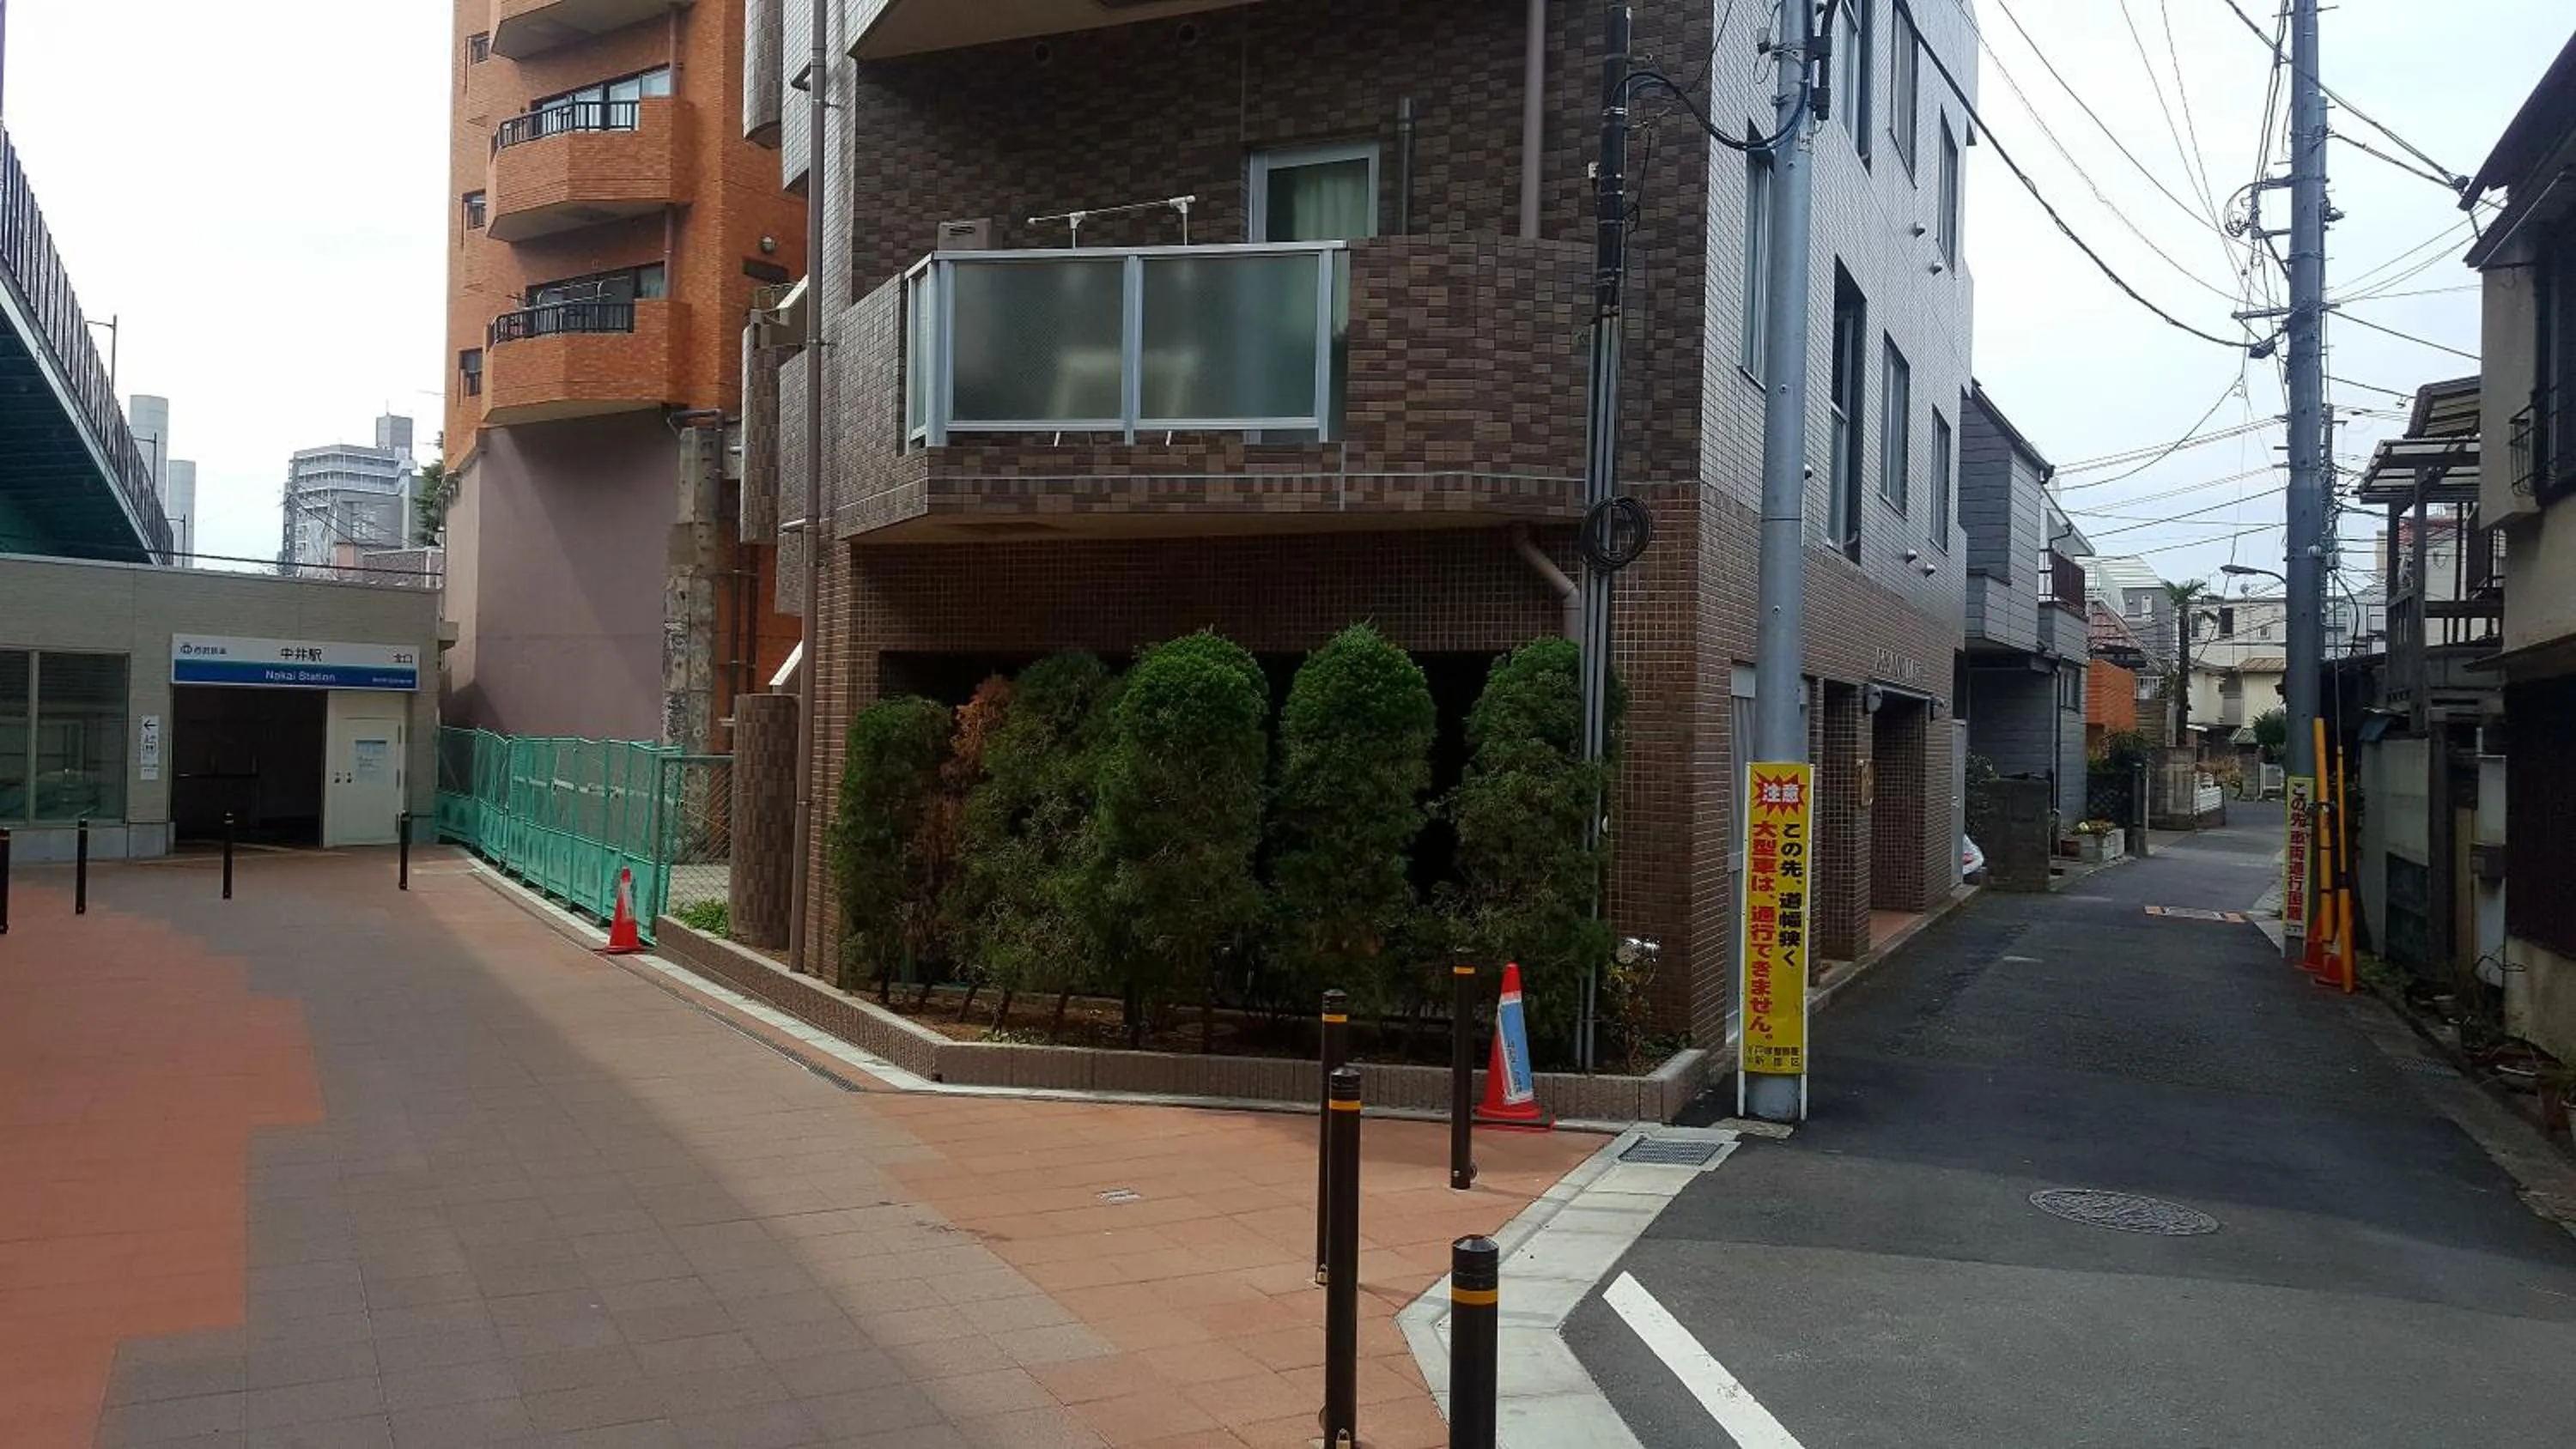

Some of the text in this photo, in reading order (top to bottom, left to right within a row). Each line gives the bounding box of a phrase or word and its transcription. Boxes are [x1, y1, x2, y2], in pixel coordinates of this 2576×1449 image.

[280, 647, 324, 662] 中井駅
[264, 669, 336, 682] Nakai Station
[1762, 782, 1799, 803] 注意
[1779, 823, 1802, 967] この先、道幅狭く
[1749, 820, 1777, 1040] 大型車は、通行できません。
